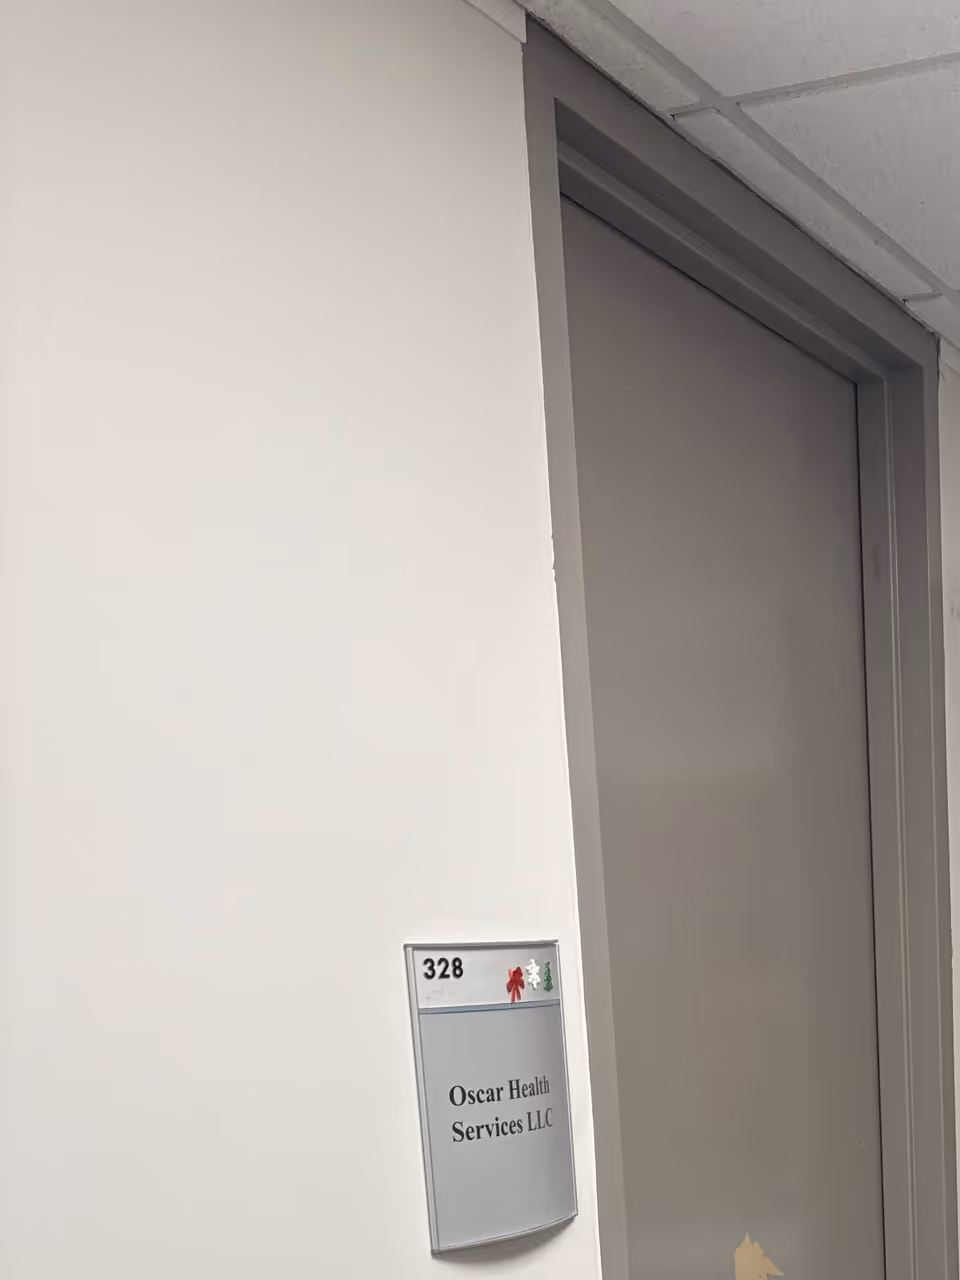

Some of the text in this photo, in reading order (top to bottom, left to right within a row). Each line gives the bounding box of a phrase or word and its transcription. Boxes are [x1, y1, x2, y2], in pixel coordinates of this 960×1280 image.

[422, 956, 464, 981] 328
[448, 1074, 550, 1107] Oscar Health
[451, 1107, 554, 1143] Services LLC
